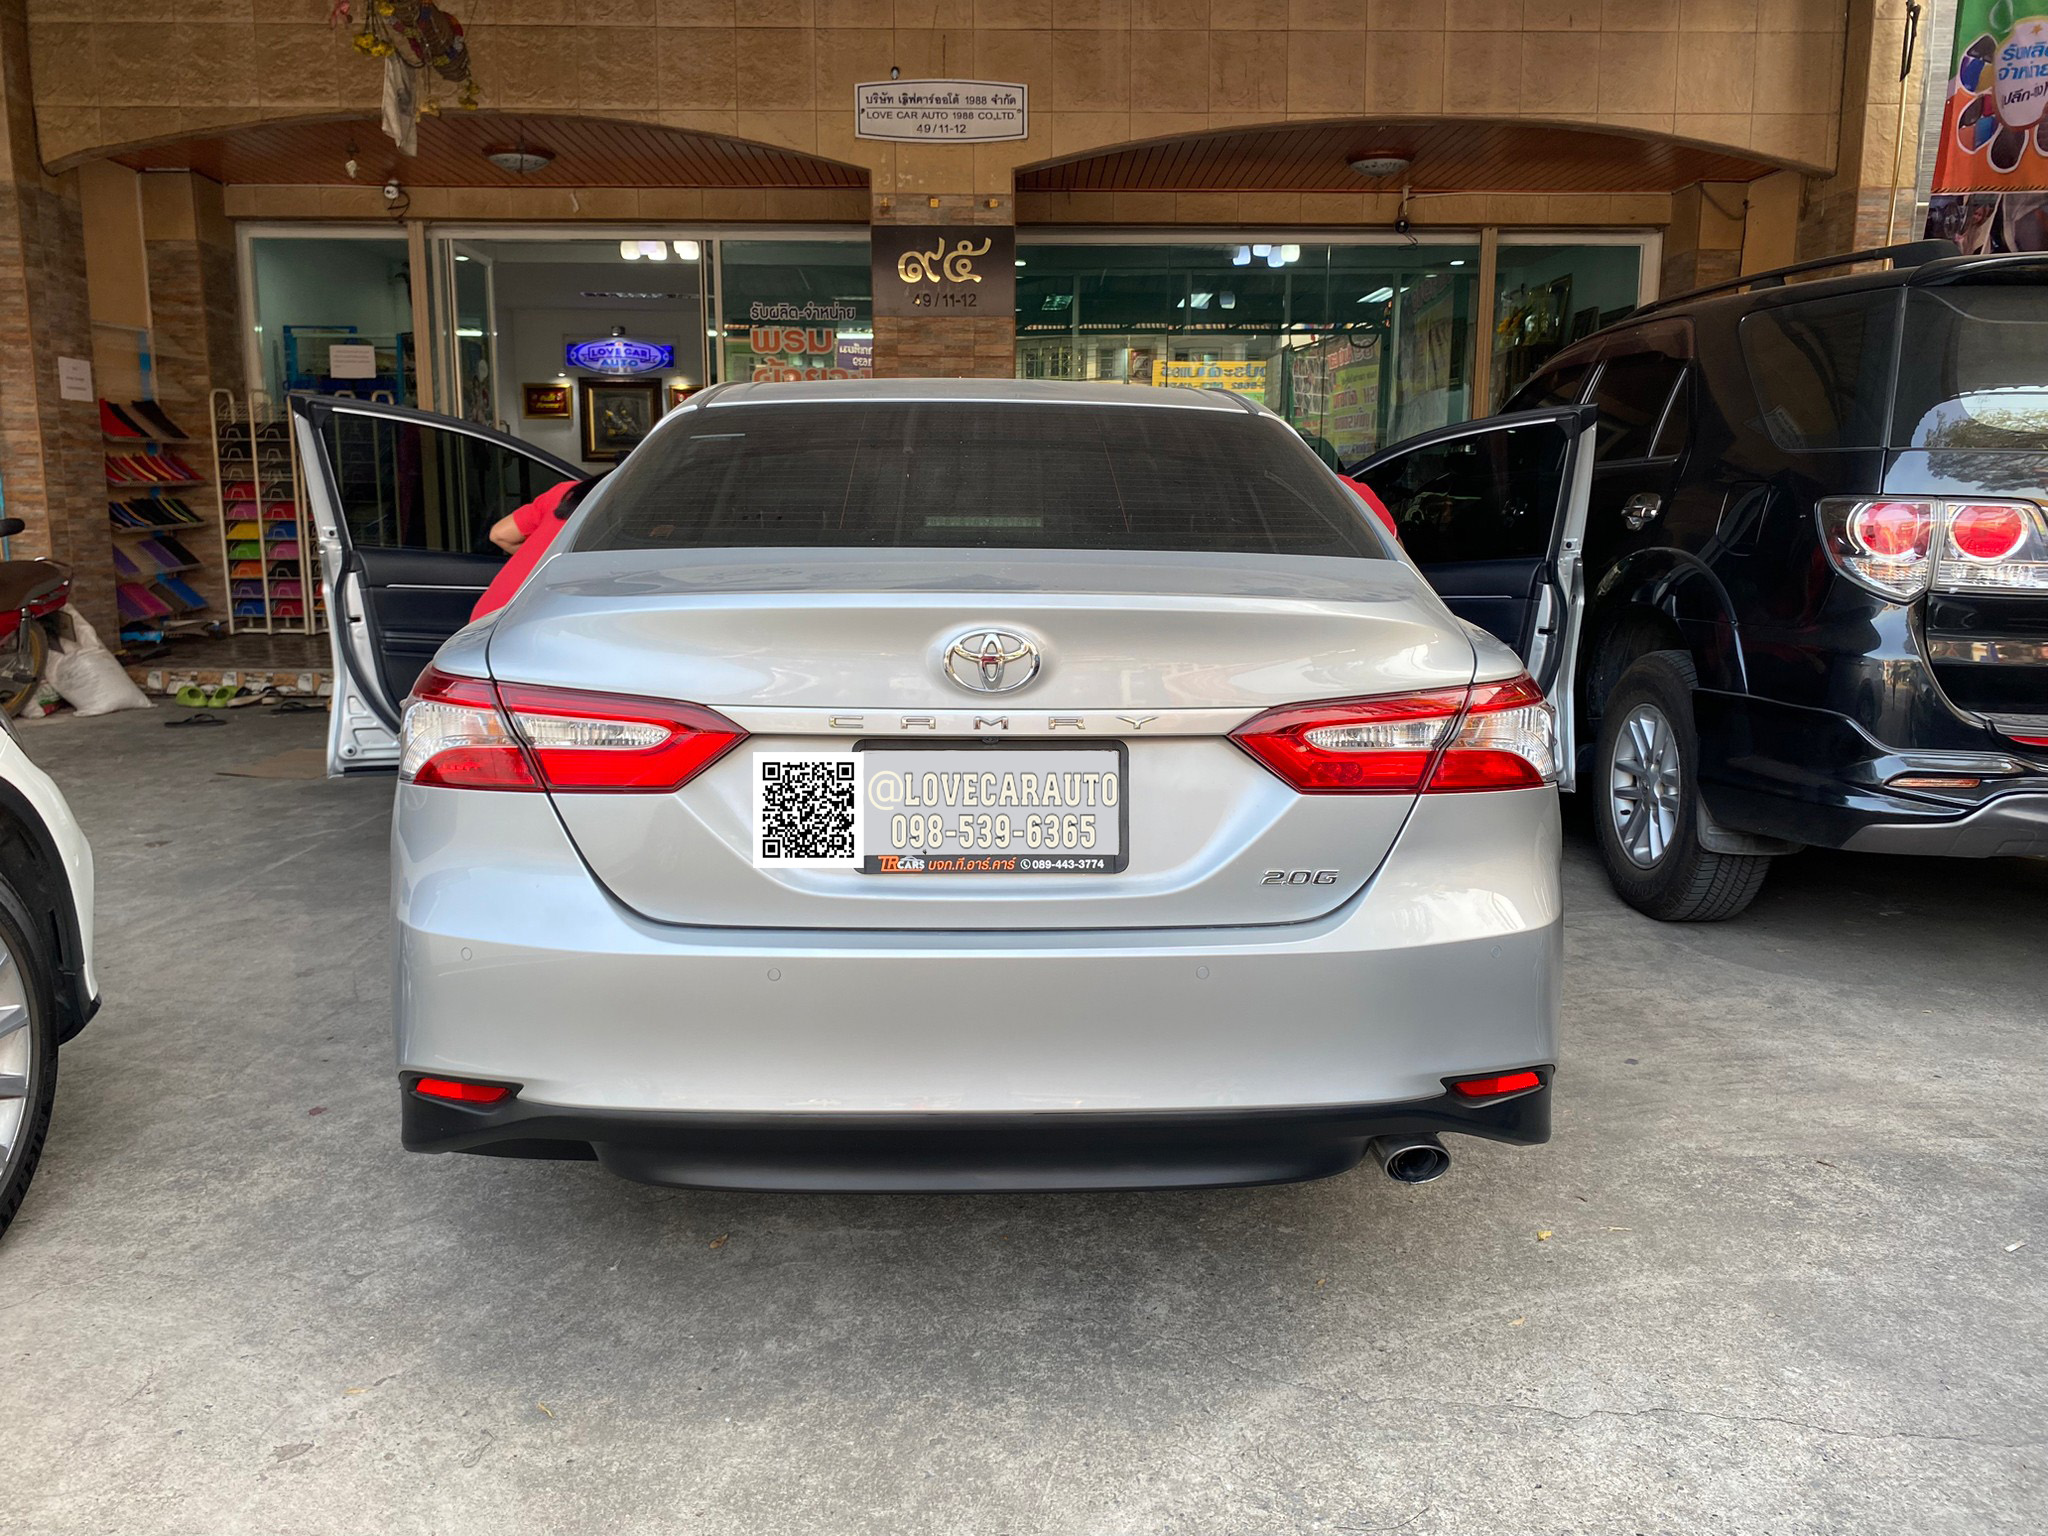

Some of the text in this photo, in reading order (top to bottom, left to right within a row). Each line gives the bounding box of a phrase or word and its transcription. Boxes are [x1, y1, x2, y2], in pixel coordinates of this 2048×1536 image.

[866, 92, 894, 104] บริษัท
[965, 96, 987, 105] 1988
[991, 93, 1016, 105] จำกัด
[866, 111, 893, 120] LOVE
[896, 111, 918, 120] CAR
[921, 111, 948, 120] AUTO
[953, 112, 974, 120] 1988
[750, 301, 856, 320] รับผลิต-จำหน่าย
[751, 328, 834, 354] พรม
[592, 348, 647, 358] LOVE CAR
[600, 359, 639, 367] AUTO
[828, 715, 1159, 730] CAMRY
[1032, 859, 1104, 869] 089-443-3774
[1260, 869, 1340, 886] 2.0G
